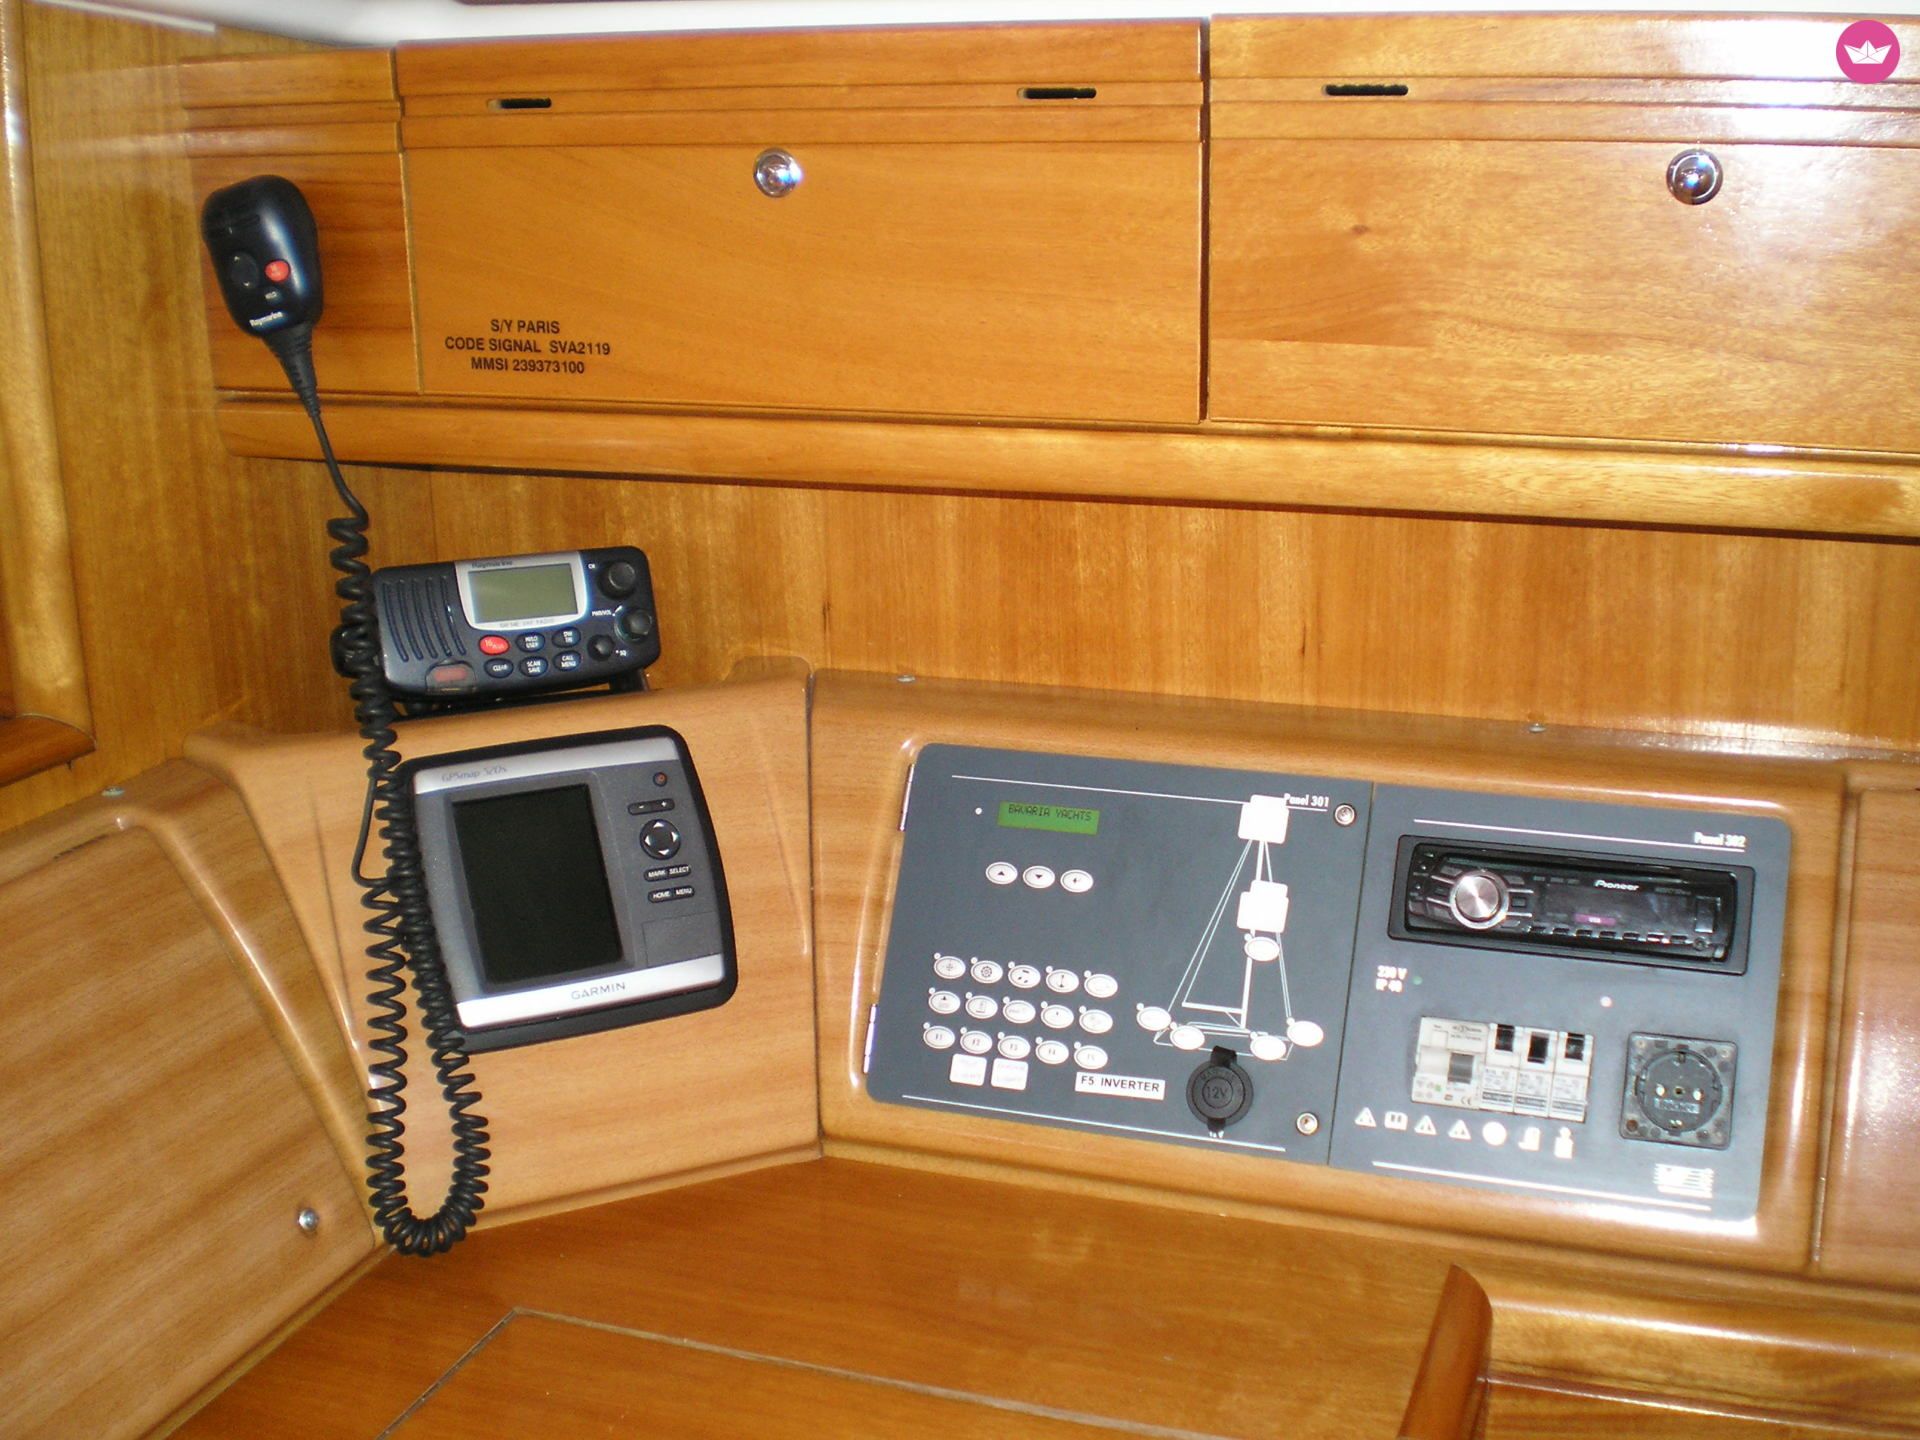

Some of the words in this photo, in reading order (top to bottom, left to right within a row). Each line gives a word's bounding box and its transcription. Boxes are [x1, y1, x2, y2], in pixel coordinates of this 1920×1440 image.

[490, 319, 513, 333] S/Y
[517, 319, 560, 334] PARIS
[445, 336, 484, 350] CODE
[489, 338, 541, 353] SIGNAL
[549, 340, 611, 355] SVA2119
[471, 357, 508, 371] MMSI
[513, 359, 585, 374] 239373100
[1284, 793, 1309, 806] Panel
[1311, 796, 1329, 807] 301
[1008, 803, 1050, 817] BAVARIA
[1056, 808, 1092, 821] YACHTS
[648, 869, 666, 878] MARK
[669, 866, 690, 875] SELECT
[675, 887, 693, 895] MENU
[1594, 879, 1640, 891] Pioneer
[652, 891, 671, 899] HOME
[571, 981, 626, 1000] GARMIN
[1081, 1076, 1094, 1086] F5
[1101, 1078, 1160, 1092] INVERTER
